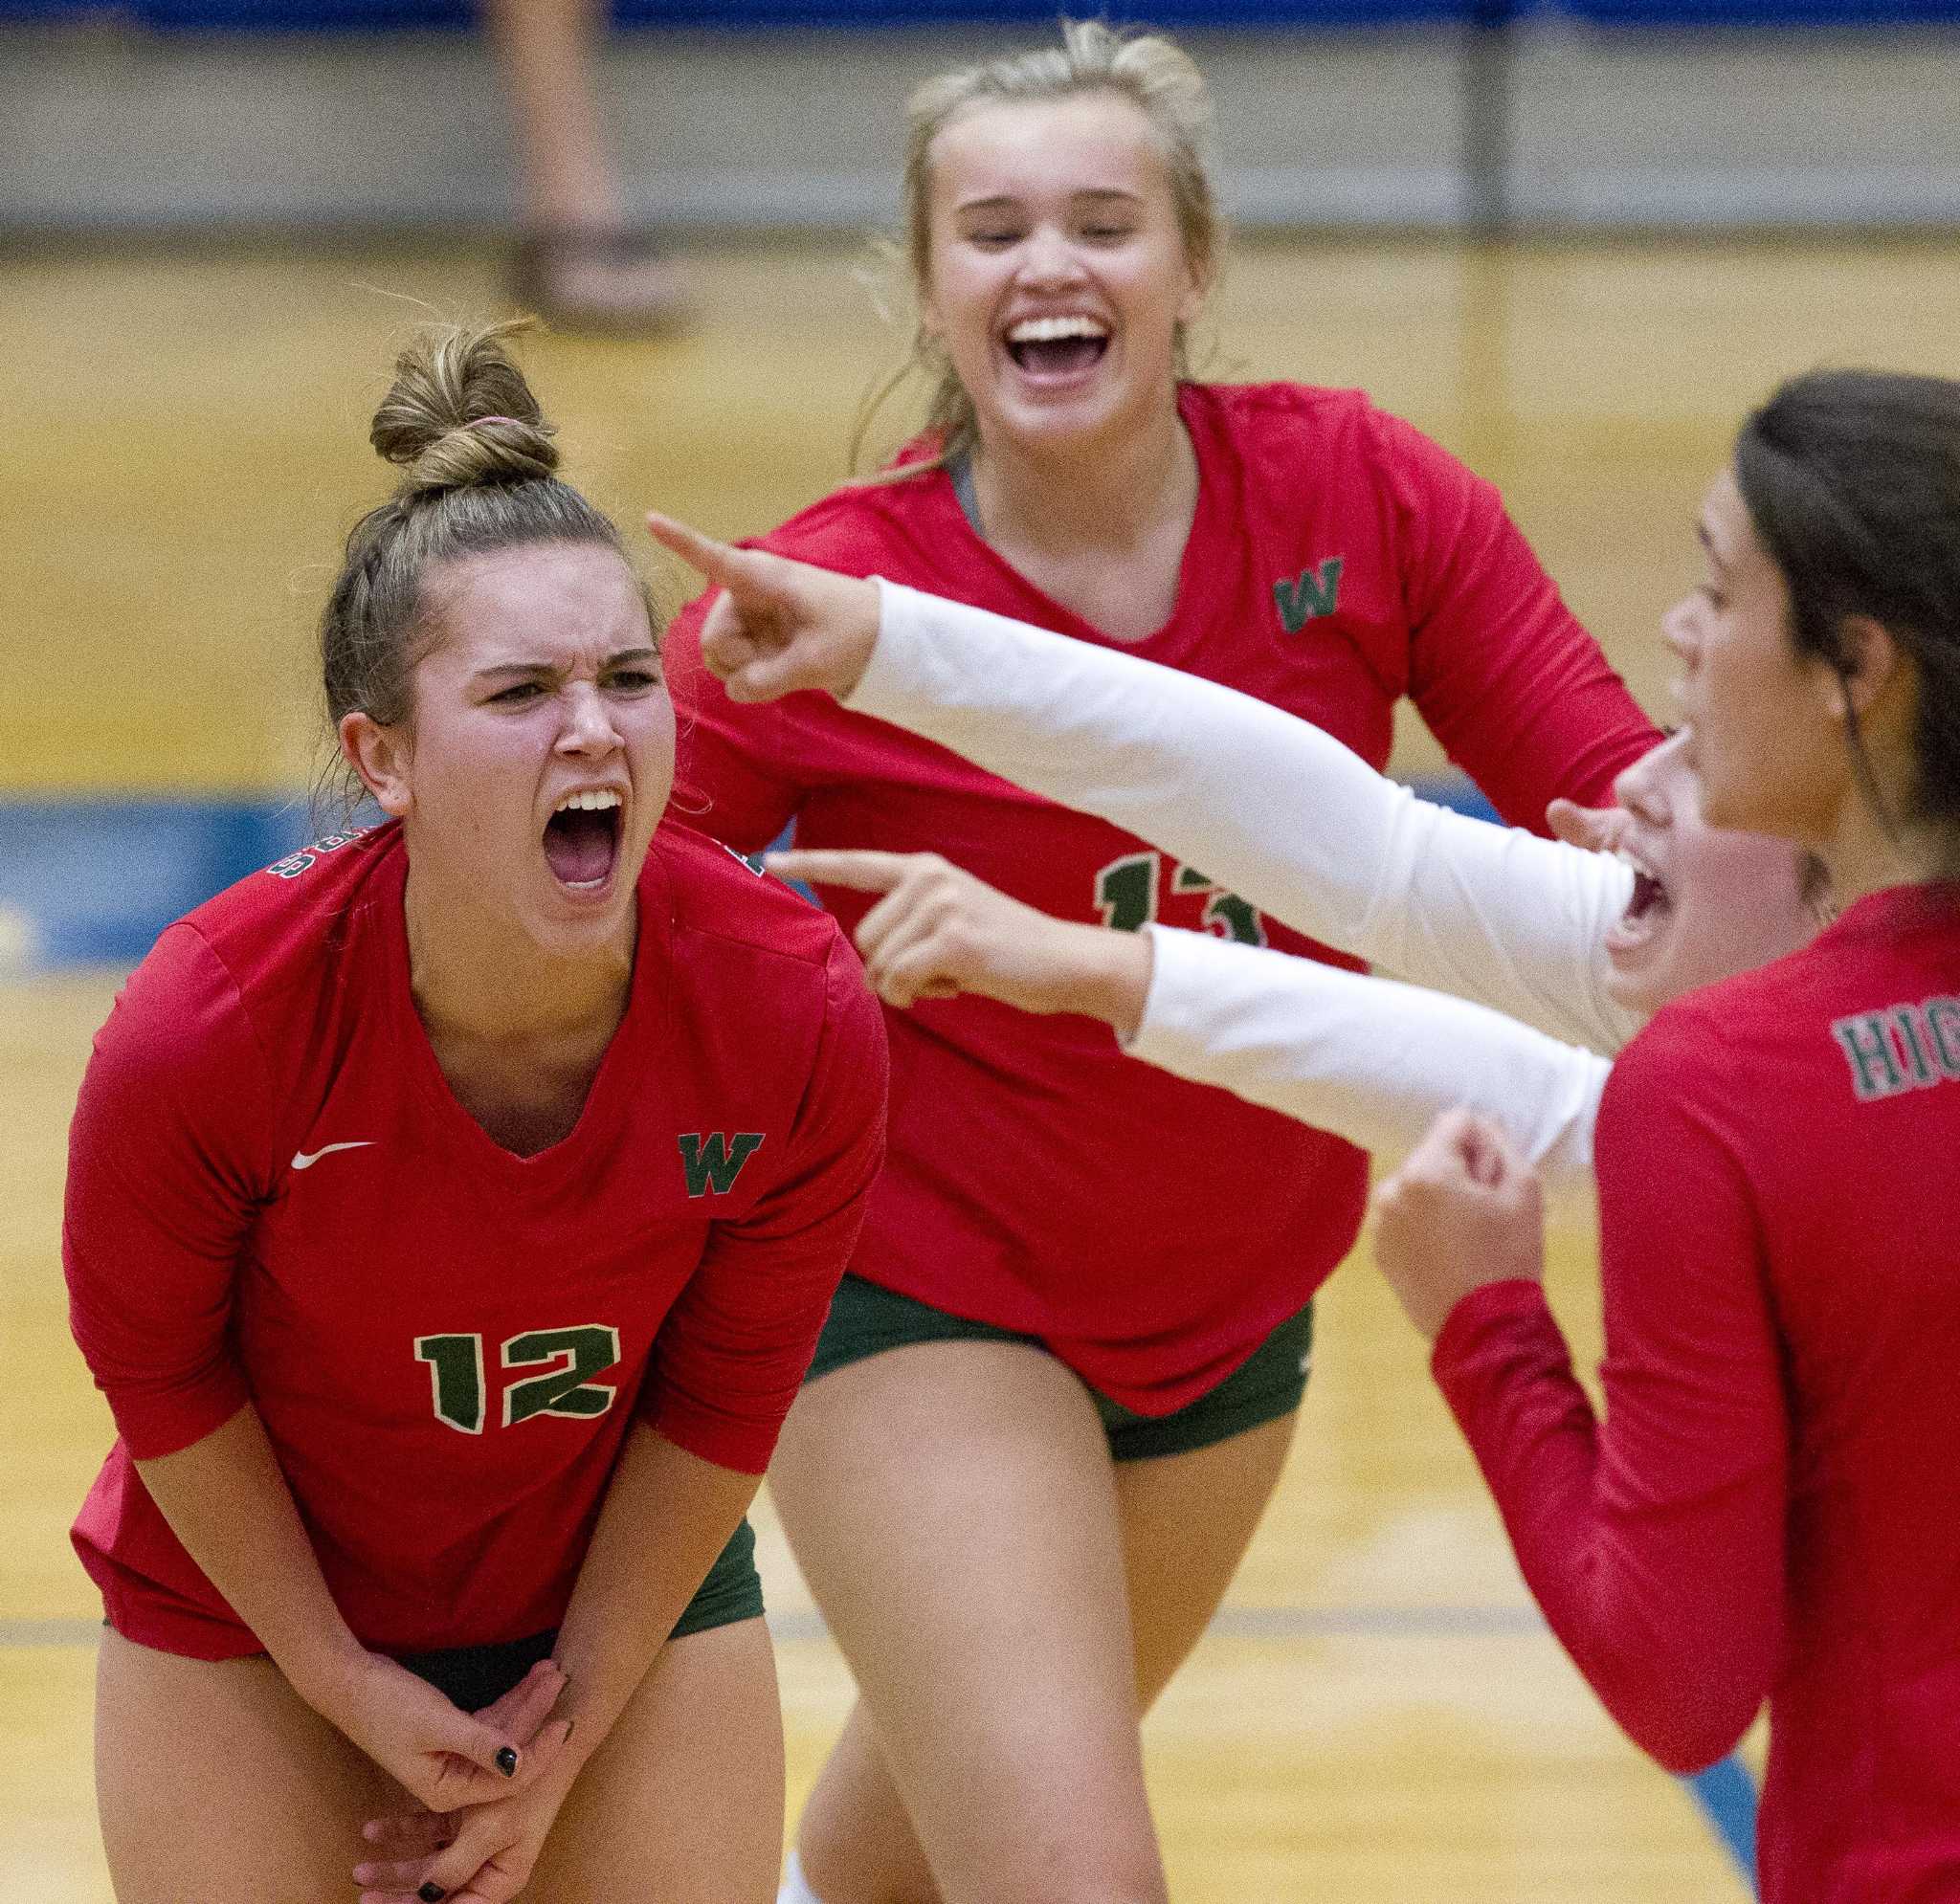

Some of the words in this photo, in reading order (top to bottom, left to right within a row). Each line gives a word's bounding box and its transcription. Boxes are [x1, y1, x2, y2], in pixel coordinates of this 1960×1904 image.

[1273, 555, 1344, 633] W
[678, 1131, 766, 1198] W
[413, 1323, 621, 1435] 12
